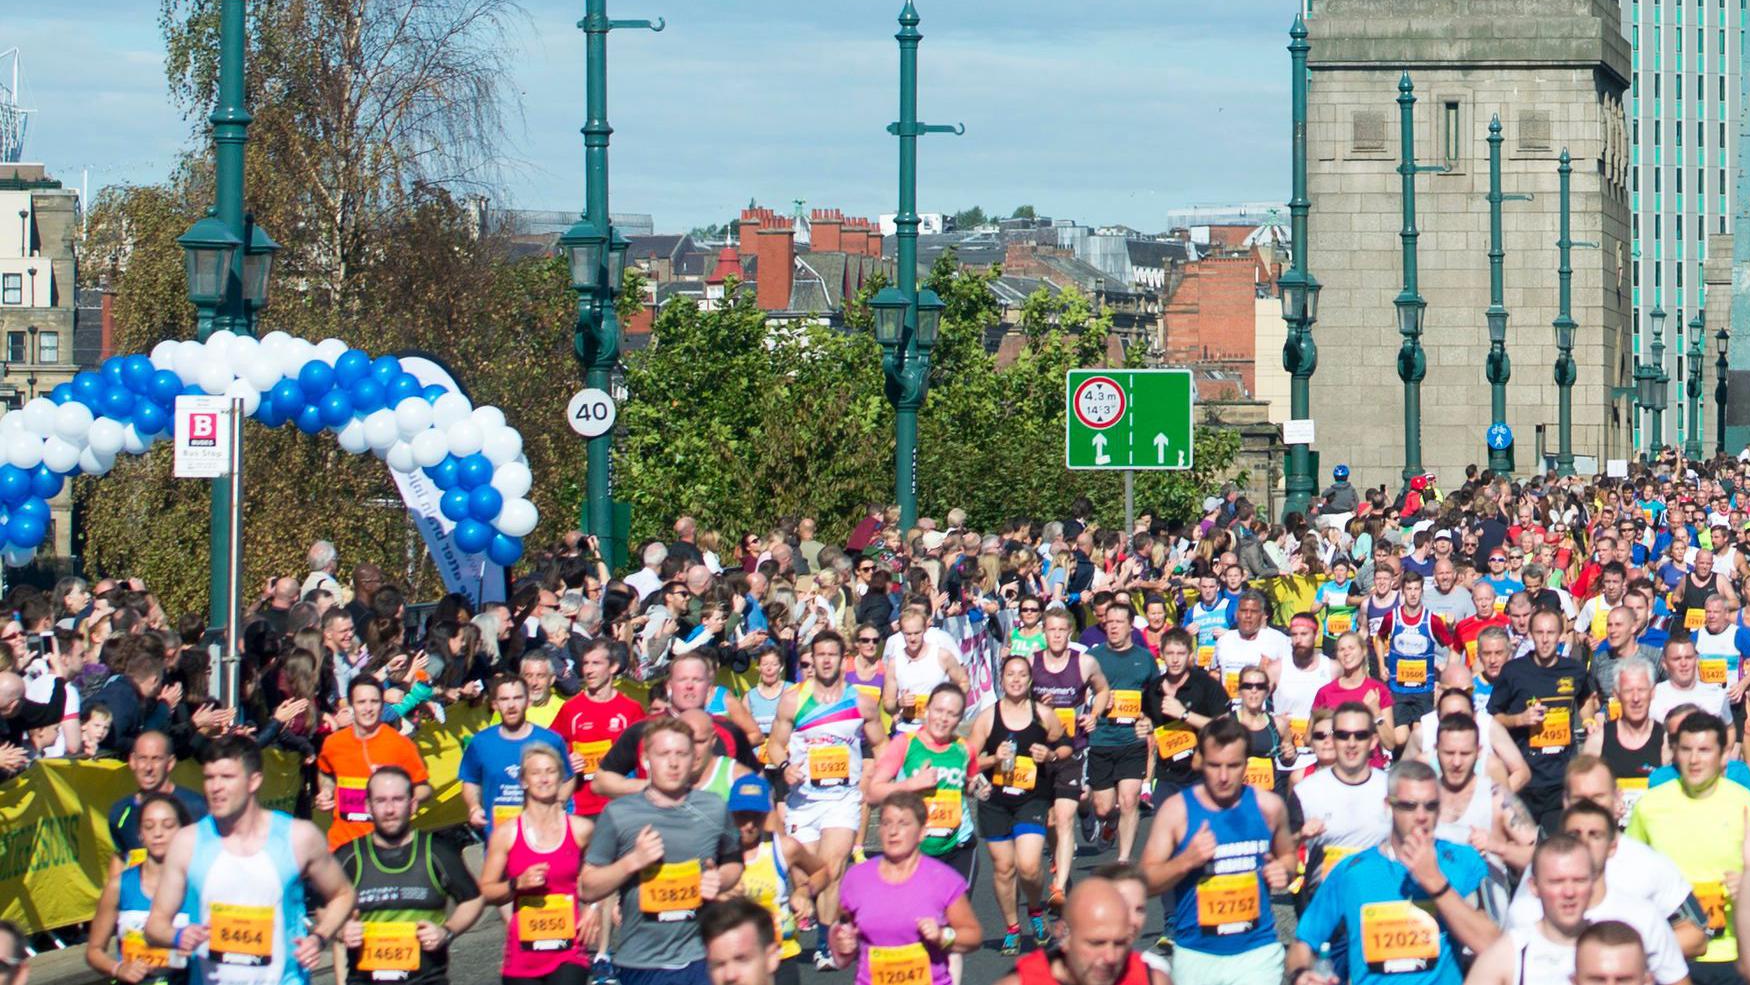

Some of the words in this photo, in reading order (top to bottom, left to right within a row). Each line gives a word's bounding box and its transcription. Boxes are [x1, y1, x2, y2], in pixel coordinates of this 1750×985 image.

[1084, 390, 1105, 401] 4.3
[1107, 393, 1117, 401] m
[575, 401, 608, 421] 40
[193, 415, 213, 436] B
[1166, 736, 1190, 750] 9903
[813, 761, 848, 773] 15932
[648, 885, 699, 902] 13828
[1207, 897, 1256, 914] 12752
[529, 916, 566, 932] 9850
[219, 926, 264, 944] 8464
[1373, 931, 1431, 948] 12023
[363, 947, 415, 961] 14687
[876, 966, 925, 985] 12047
